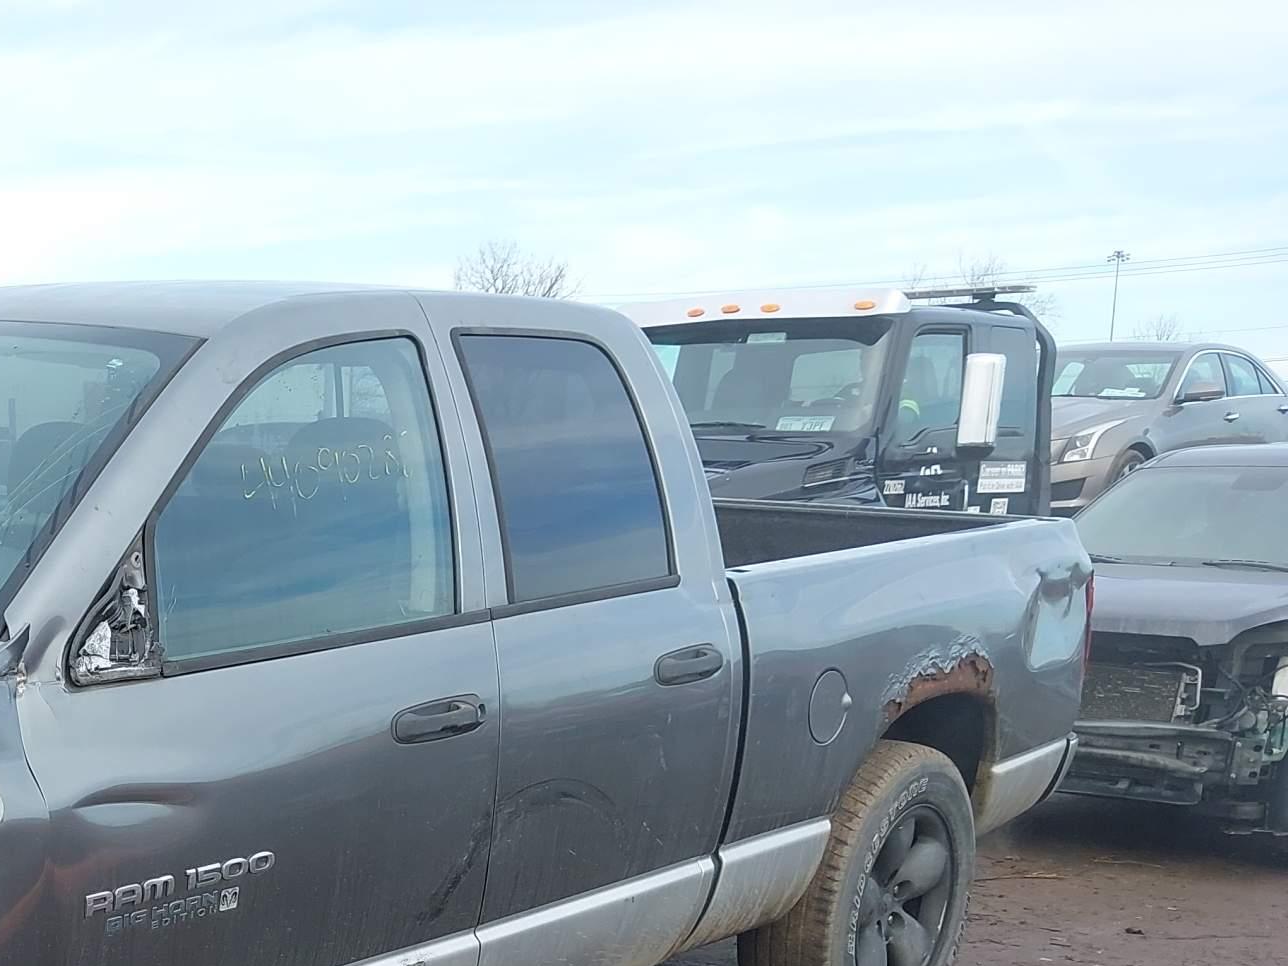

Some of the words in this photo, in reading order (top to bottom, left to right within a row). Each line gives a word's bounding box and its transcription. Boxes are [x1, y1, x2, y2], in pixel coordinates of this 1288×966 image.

[905, 494, 917, 508] IAA
[85, 874, 175, 918] RAM
[186, 851, 275, 890] 1500
[106, 908, 148, 936] BIG
[152, 891, 218, 920] HORN
[152, 903, 218, 929] EDITION
